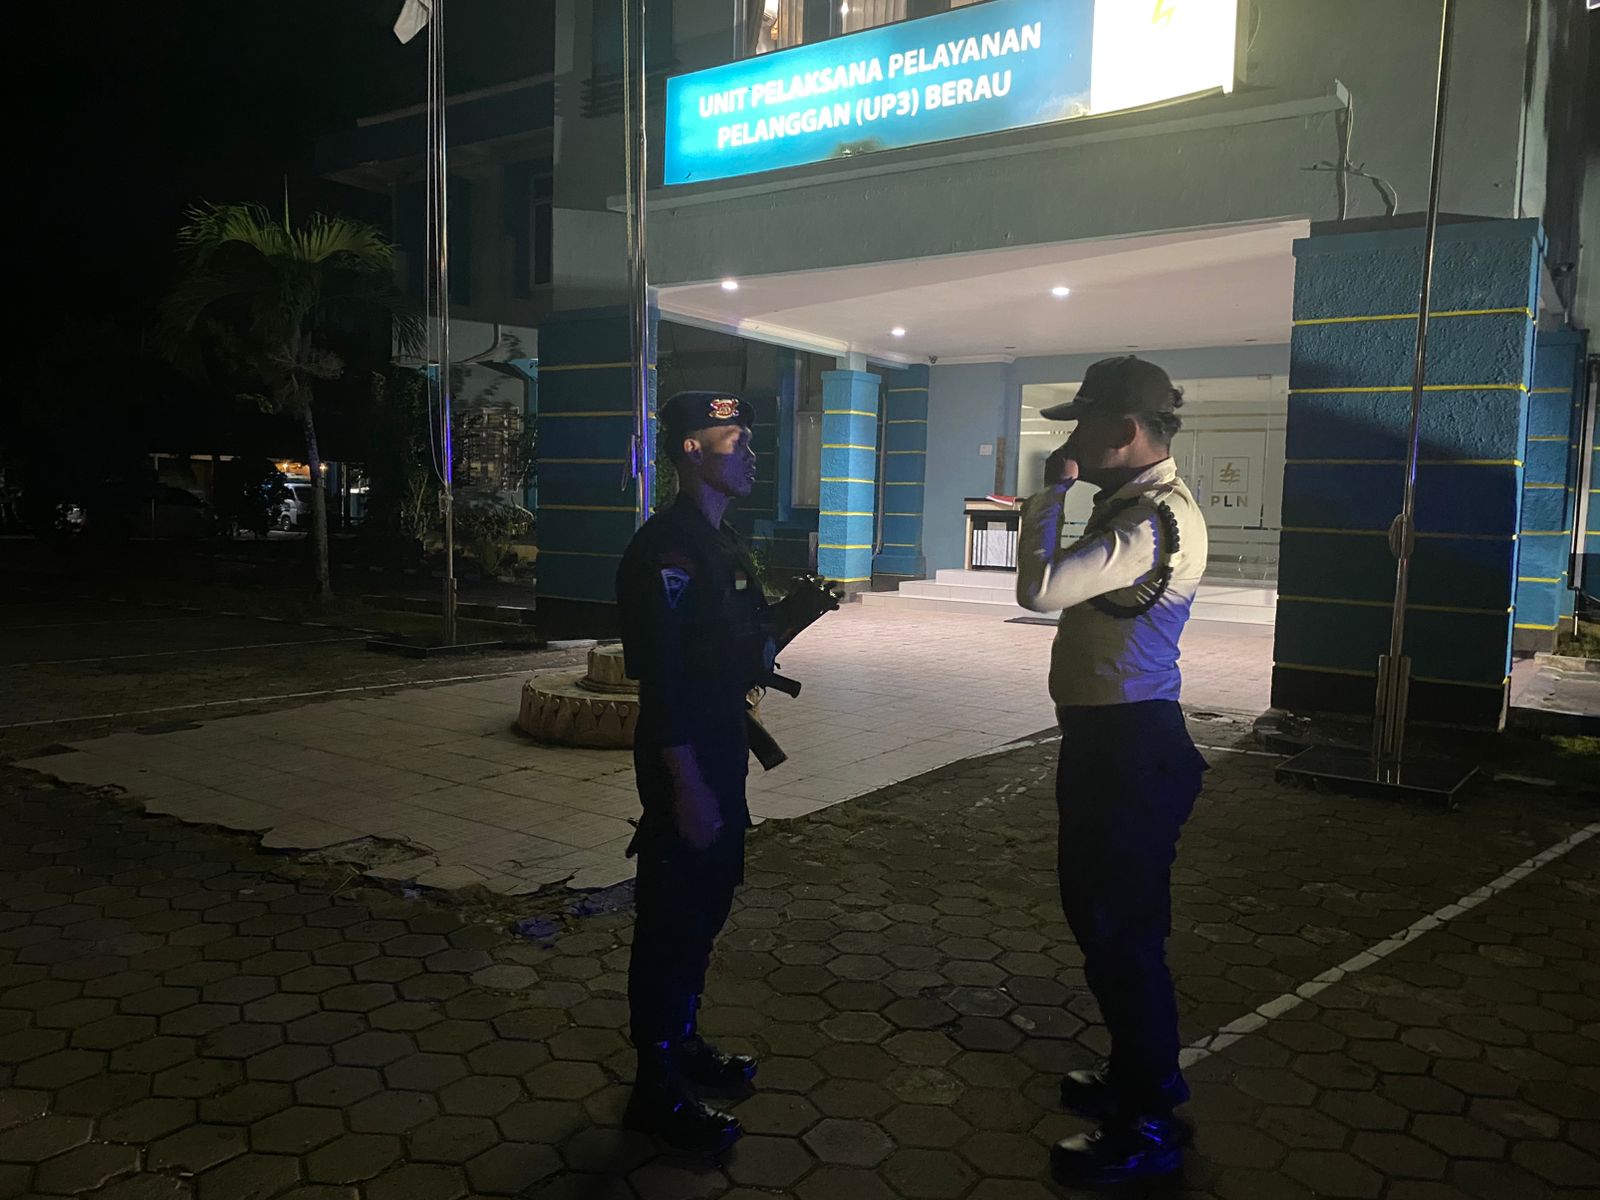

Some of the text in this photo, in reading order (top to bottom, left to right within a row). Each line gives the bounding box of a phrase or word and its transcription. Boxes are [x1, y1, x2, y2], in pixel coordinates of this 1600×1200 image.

[699, 21, 1042, 118] UNIT PELAKSANA PELAYANAN
[717, 69, 1012, 149] PELANGGAN (UP3) BERAU
